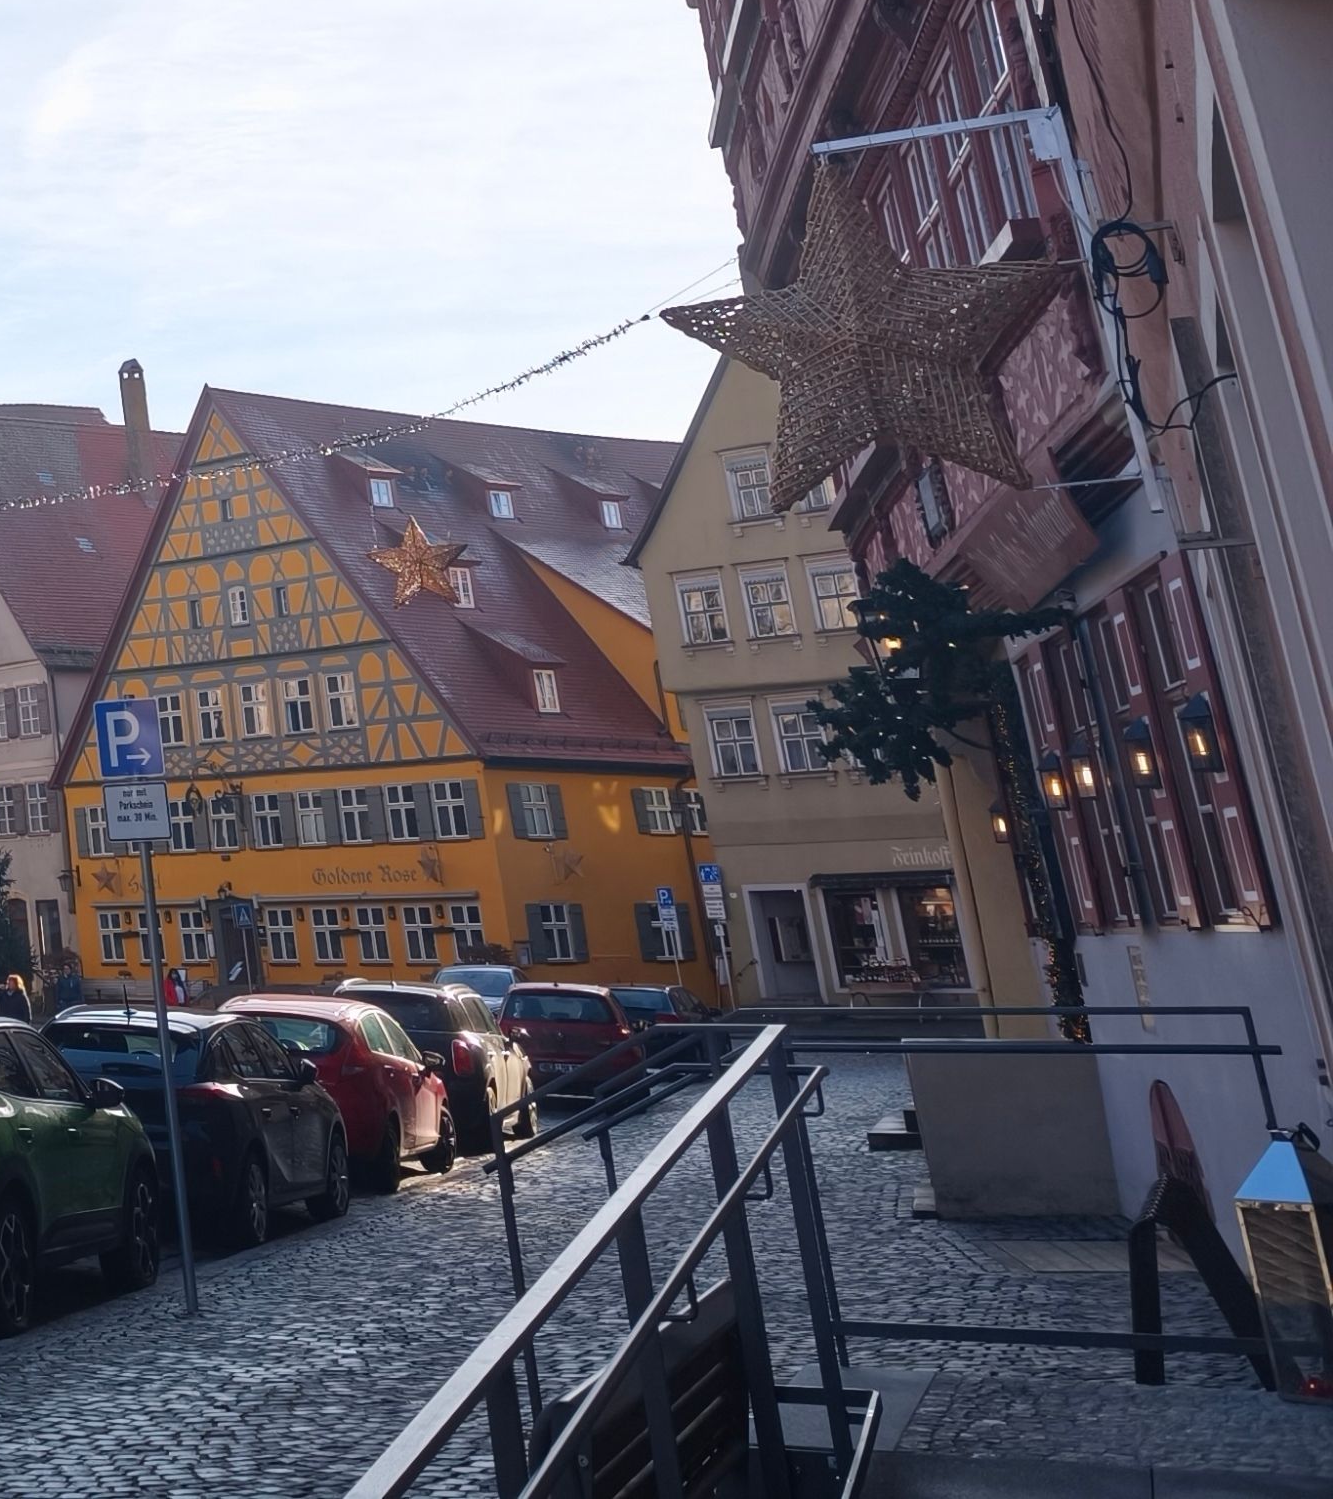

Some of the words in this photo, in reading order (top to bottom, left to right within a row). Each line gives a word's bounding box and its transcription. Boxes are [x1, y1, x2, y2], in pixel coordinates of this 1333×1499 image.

[106, 710, 139, 767] P
[119, 800, 154, 811] Parkschein
[134, 813, 143, 822] 30
[312, 867, 373, 885] Goldene
[378, 864, 417, 883] Rose
